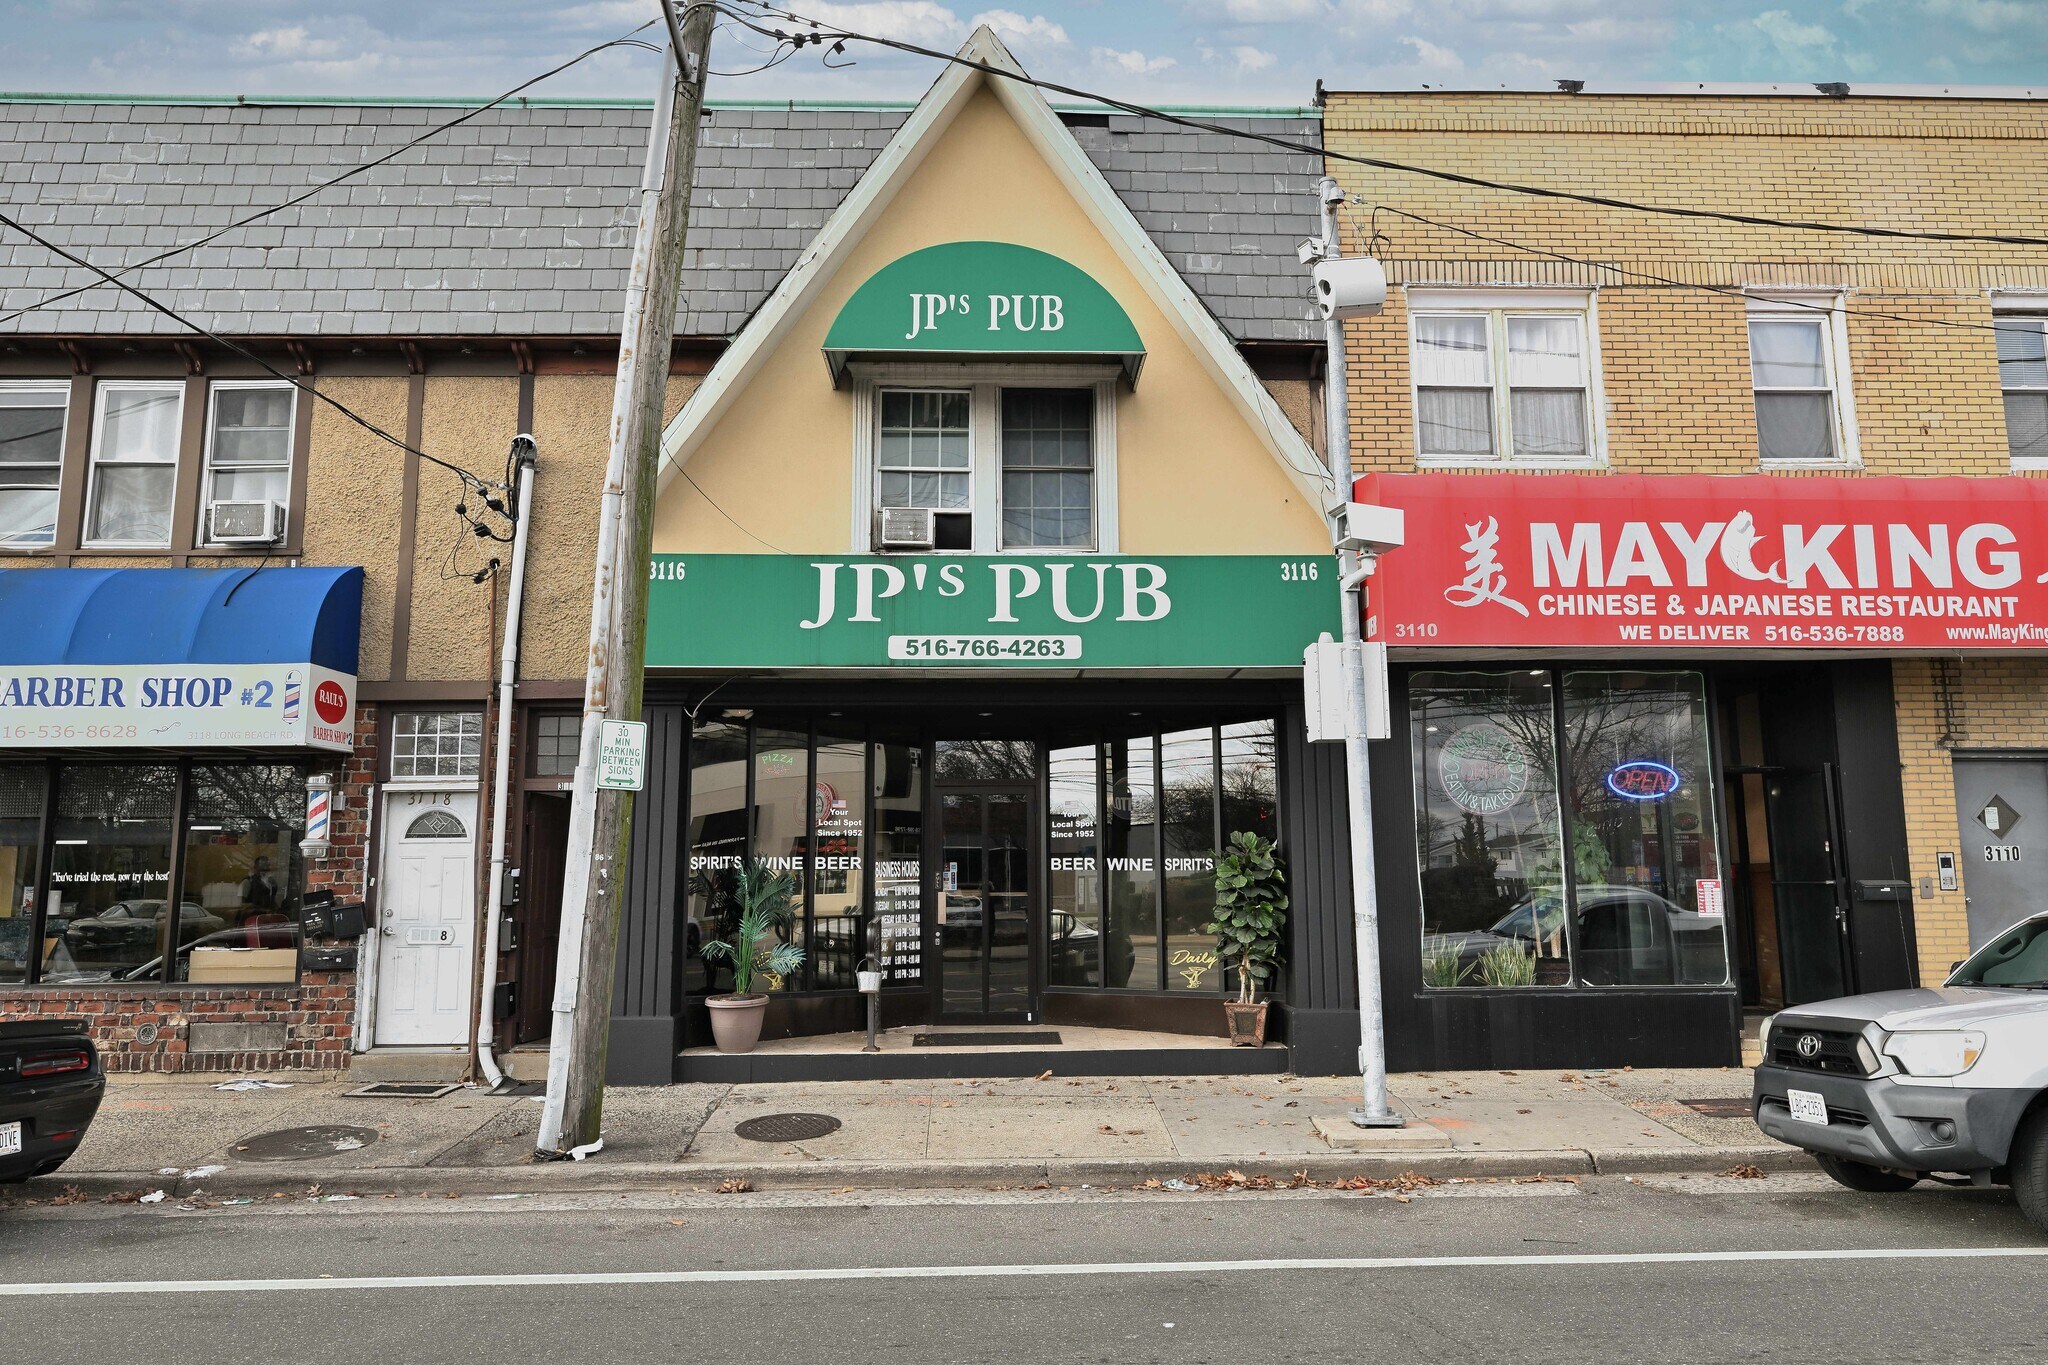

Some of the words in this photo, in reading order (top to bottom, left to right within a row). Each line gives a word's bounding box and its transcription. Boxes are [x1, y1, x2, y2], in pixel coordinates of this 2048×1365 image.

[987, 294, 1064, 332] PUB
[1529, 521, 1728, 588] MAY
[1782, 522, 2022, 590] KING
[649, 561, 686, 580] 3116
[1280, 562, 1318, 581] 3116
[1443, 515, 1530, 618] 美
[987, 563, 1172, 623] PUB
[1538, 593, 1657, 616] CHINESE
[1666, 594, 1686, 615] &
[1694, 594, 1833, 617] JAPANESE
[1841, 595, 2019, 618] RESTAURANT
[1395, 623, 1438, 637] 3110
[1618, 625, 1652, 641] WE
[1658, 625, 1751, 641] DELIVER
[1765, 625, 1905, 642] 516-536-7888
[905, 638, 1066, 657] 516-766-4263
[0, 676, 126, 708] ARBER
[140, 677, 232, 708] SHOP
[240, 680, 274, 708] #2
[319, 689, 344, 708] RAUL'S
[188, 731, 211, 740] 3118
[214, 731, 241, 740] LONG
[244, 730, 277, 739] BEACH
[312, 725, 334, 742] BARBER
[334, 730, 346, 744] SHOP
[617, 727, 629, 737] 30
[615, 737, 631, 747] MIN
[603, 745, 640, 757] PARKING
[602, 755, 641, 767] BETWEEN
[608, 765, 634, 776] SIGNS
[1444, 773, 1466, 793] EAT
[1612, 768, 1673, 792] OPEN
[407, 791, 452, 806] 3118
[829, 808, 849, 816] Your
[1062, 810, 1080, 818] Your
[818, 819, 841, 827] Local
[843, 819, 862, 828] Spot
[1051, 820, 1074, 829] Local
[1075, 820, 1094, 829] Spot
[817, 829, 840, 837] Since
[843, 829, 863, 837] 1952
[1051, 830, 1073, 838] Since
[1074, 830, 1095, 838] 1952
[1985, 846, 2020, 861] 3110
[689, 855, 742, 870] SPIRIT'S
[815, 856, 862, 870] BEER
[875, 861, 901, 878] BUSINESS
[901, 860, 920, 878] HOURS
[1050, 857, 1096, 871] BEER
[1106, 857, 1154, 872] WINE
[1164, 857, 1214, 871] SPIRIT'S
[74, 871, 89, 882] tried
[90, 871, 101, 883] the
[102, 872, 117, 882] rest,
[118, 873, 131, 883] now
[132, 872, 142, 884] try
[143, 869, 154, 883] the
[440, 930, 448, 941] 8
[1170, 949, 1218, 970] Daily
